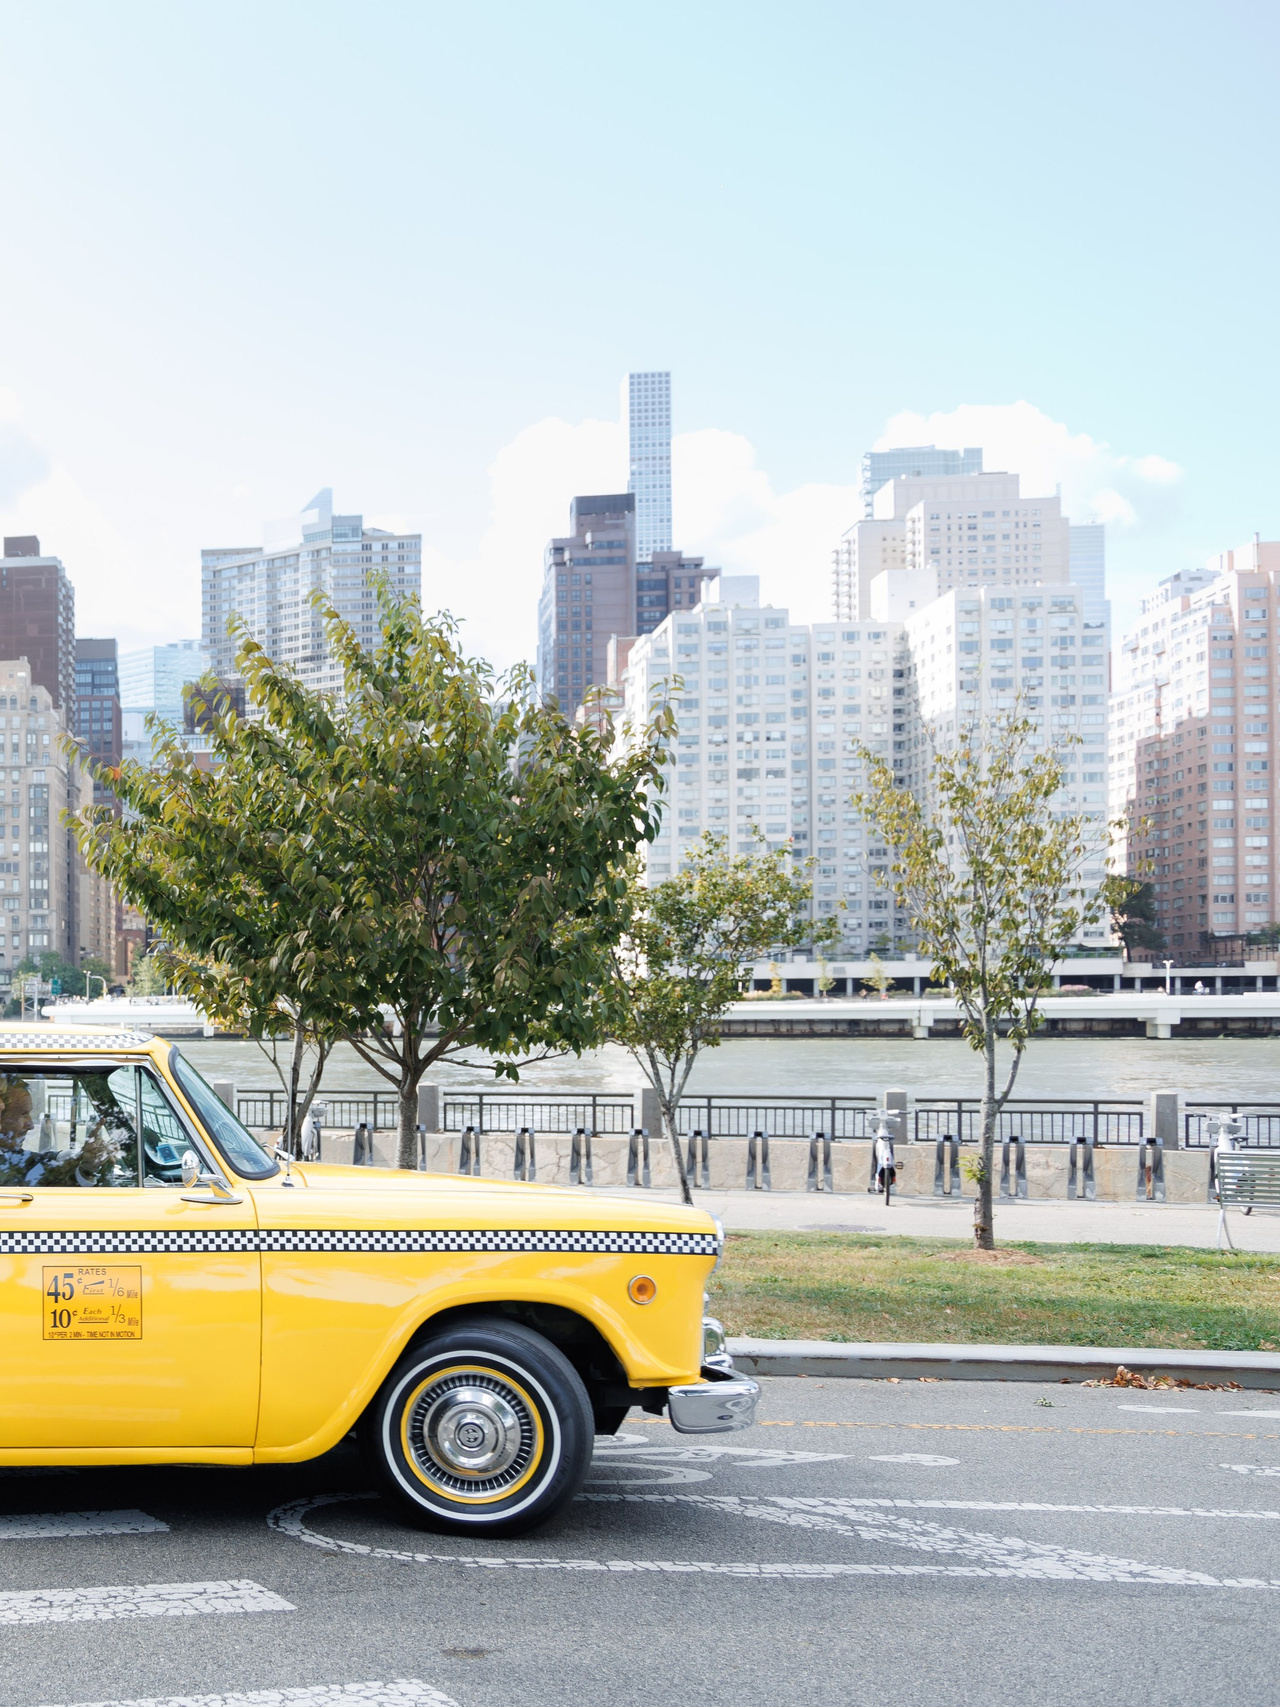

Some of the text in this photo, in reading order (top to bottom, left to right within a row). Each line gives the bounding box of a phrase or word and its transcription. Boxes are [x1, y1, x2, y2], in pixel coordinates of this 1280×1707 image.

[83, 1281, 105, 1293] First
[108, 1277, 124, 1297] 1/6
[83, 1307, 102, 1315] Each
[110, 1304, 126, 1324] 1/3
